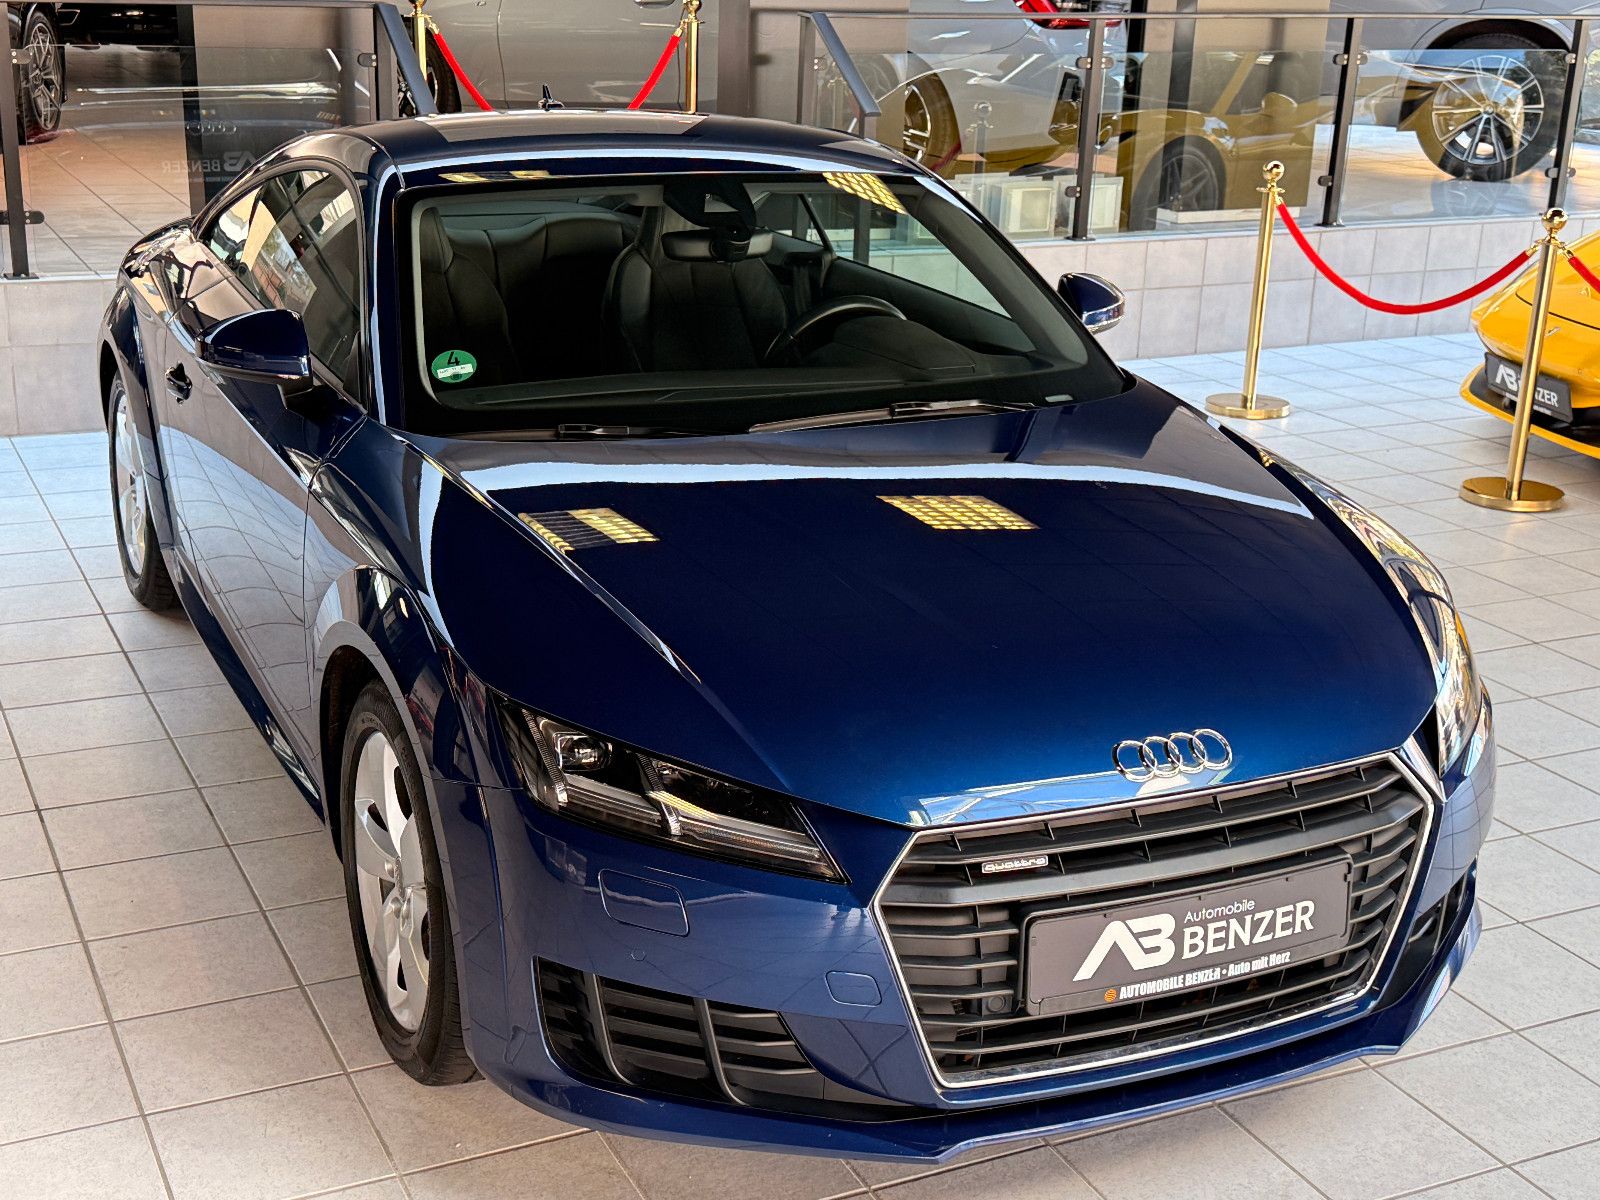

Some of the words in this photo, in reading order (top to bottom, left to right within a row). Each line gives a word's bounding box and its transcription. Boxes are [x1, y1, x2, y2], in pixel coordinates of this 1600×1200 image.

[448, 351, 460, 366] 4
[984, 857, 1046, 872] quattro
[1184, 899, 1255, 924] Automobile
[1181, 900, 1315, 960] BENZER
[1119, 976, 1184, 1000] AUTOMOBILE
[1185, 967, 1221, 987] BENZER
[1228, 962, 1251, 977] Auto
[1251, 956, 1269, 972] mit
[1268, 951, 1291, 967] Herz
